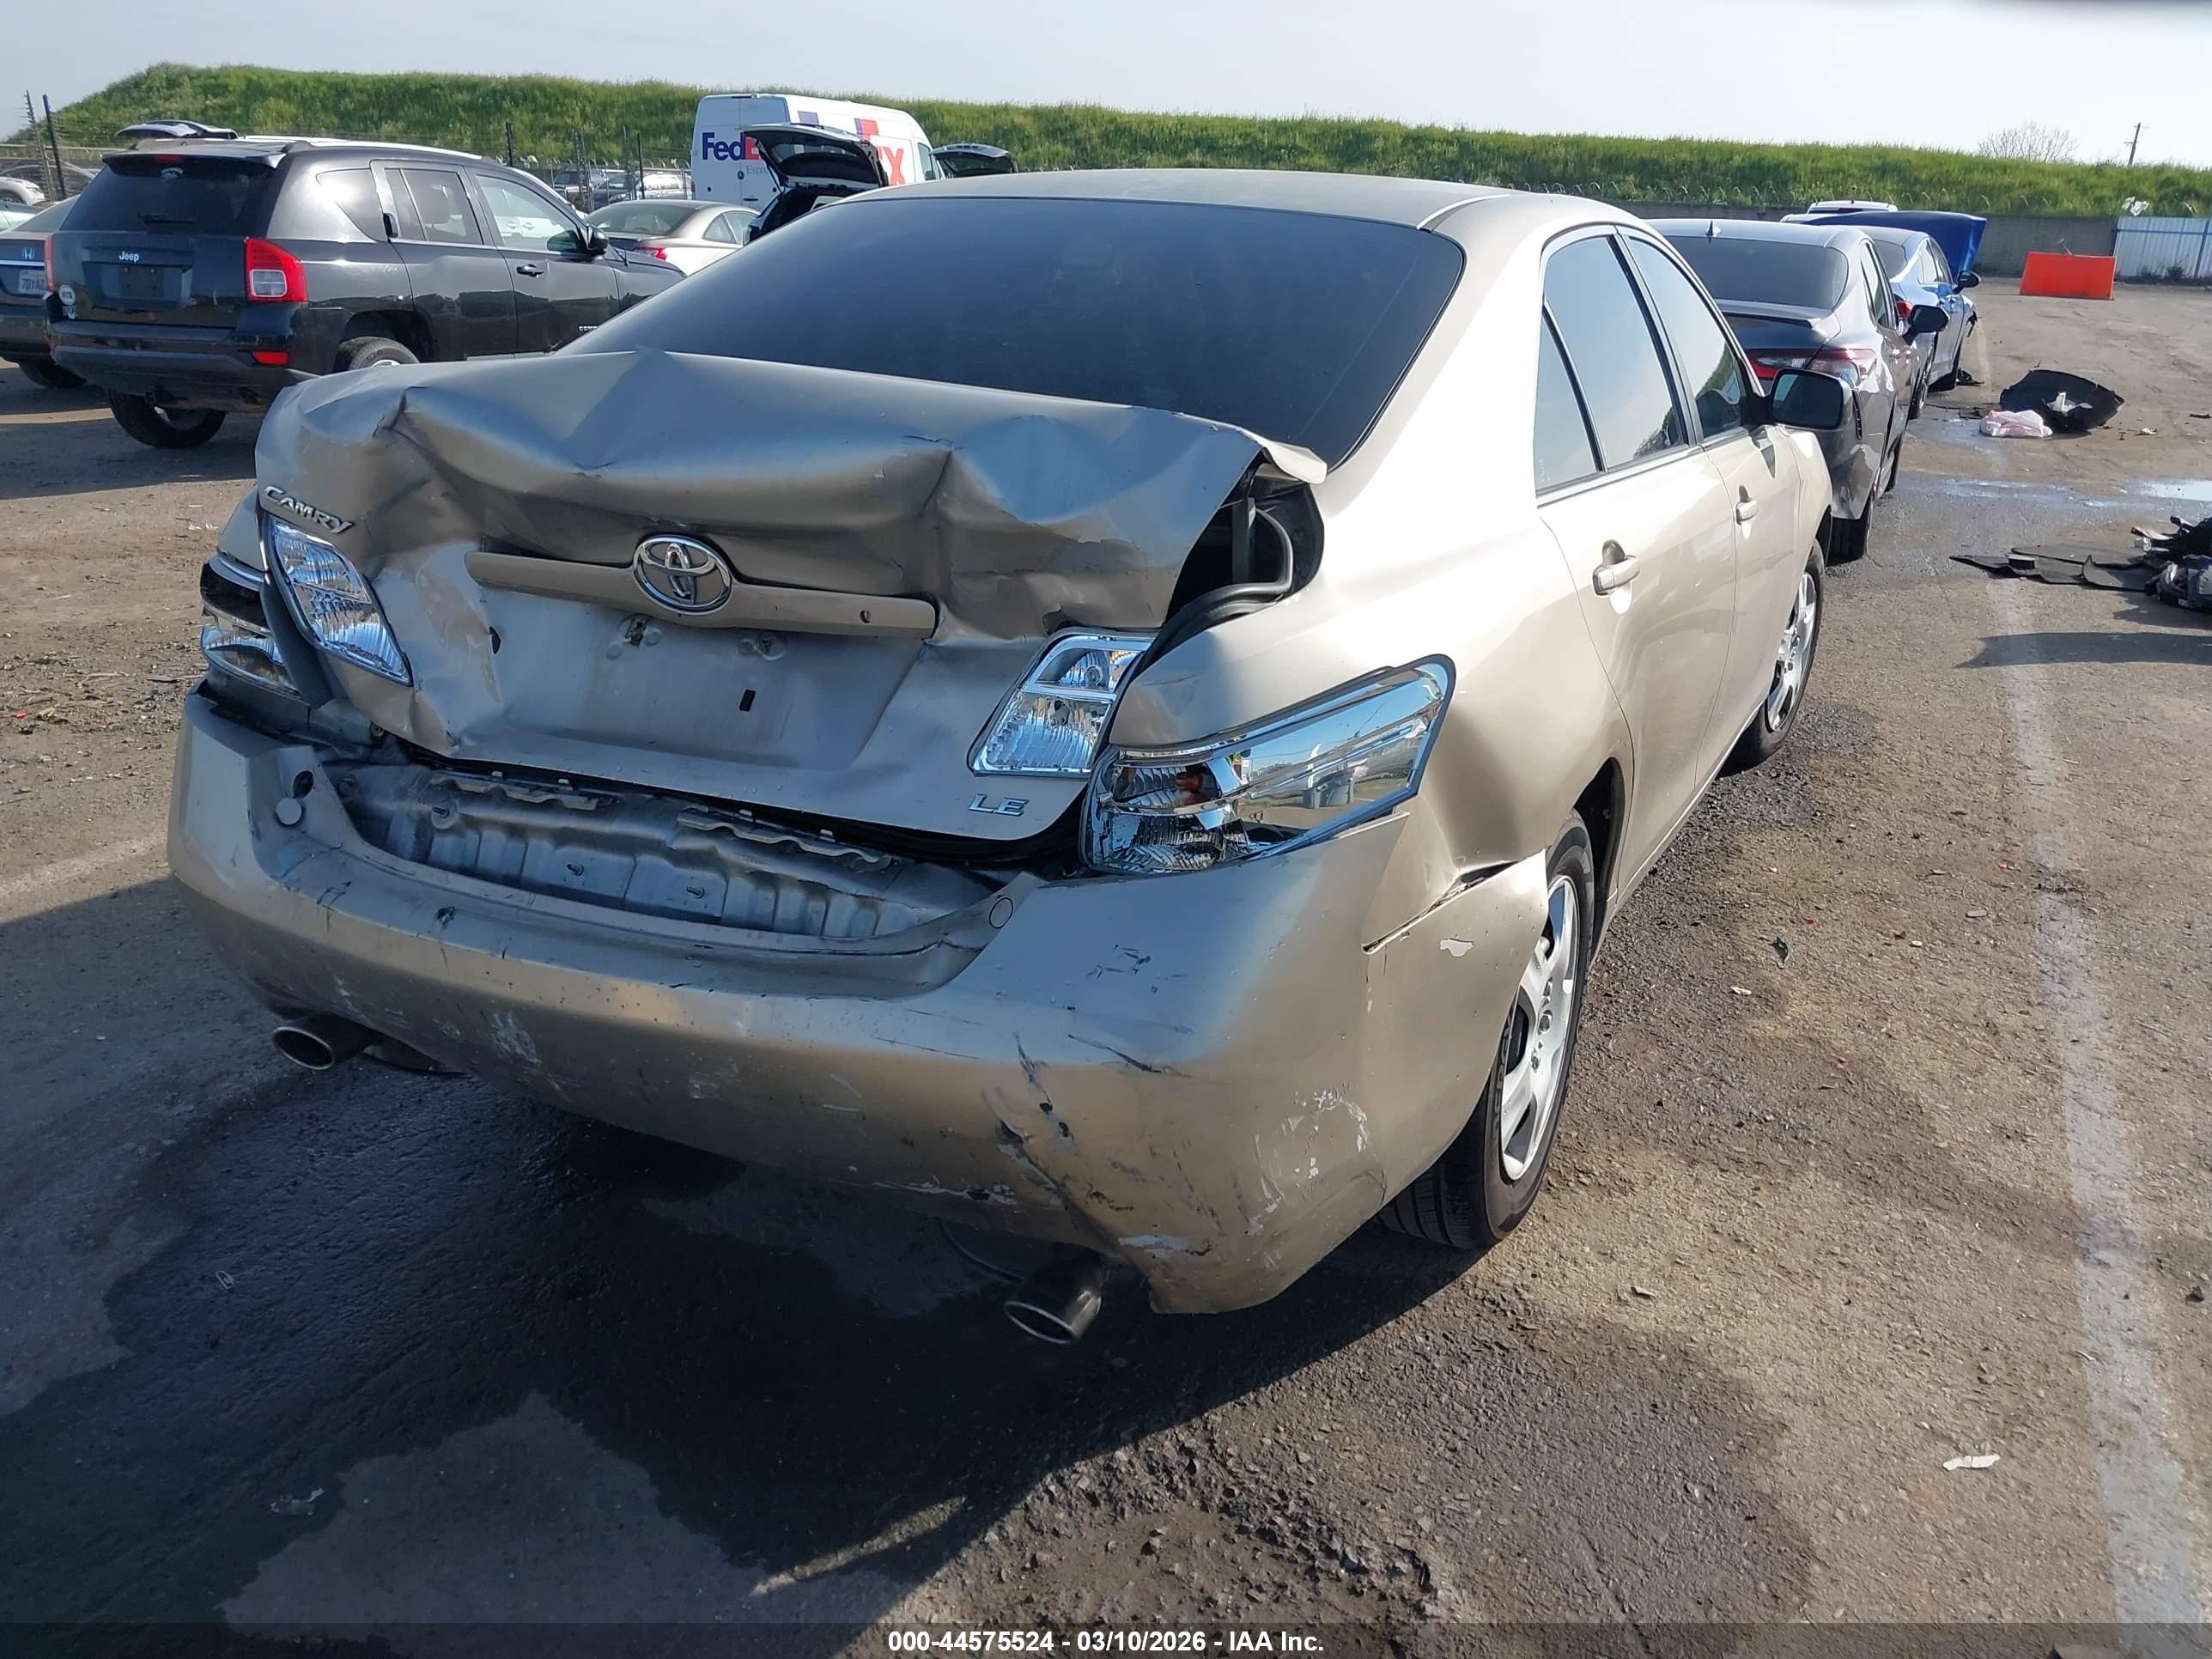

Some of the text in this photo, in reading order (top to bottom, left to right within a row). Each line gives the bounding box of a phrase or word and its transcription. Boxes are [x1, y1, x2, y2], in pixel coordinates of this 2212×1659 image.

[702, 131, 760, 161] FedE
[118, 250, 140, 264] Jeep
[264, 486, 354, 533] CAMRY
[969, 794, 1030, 817] LE
